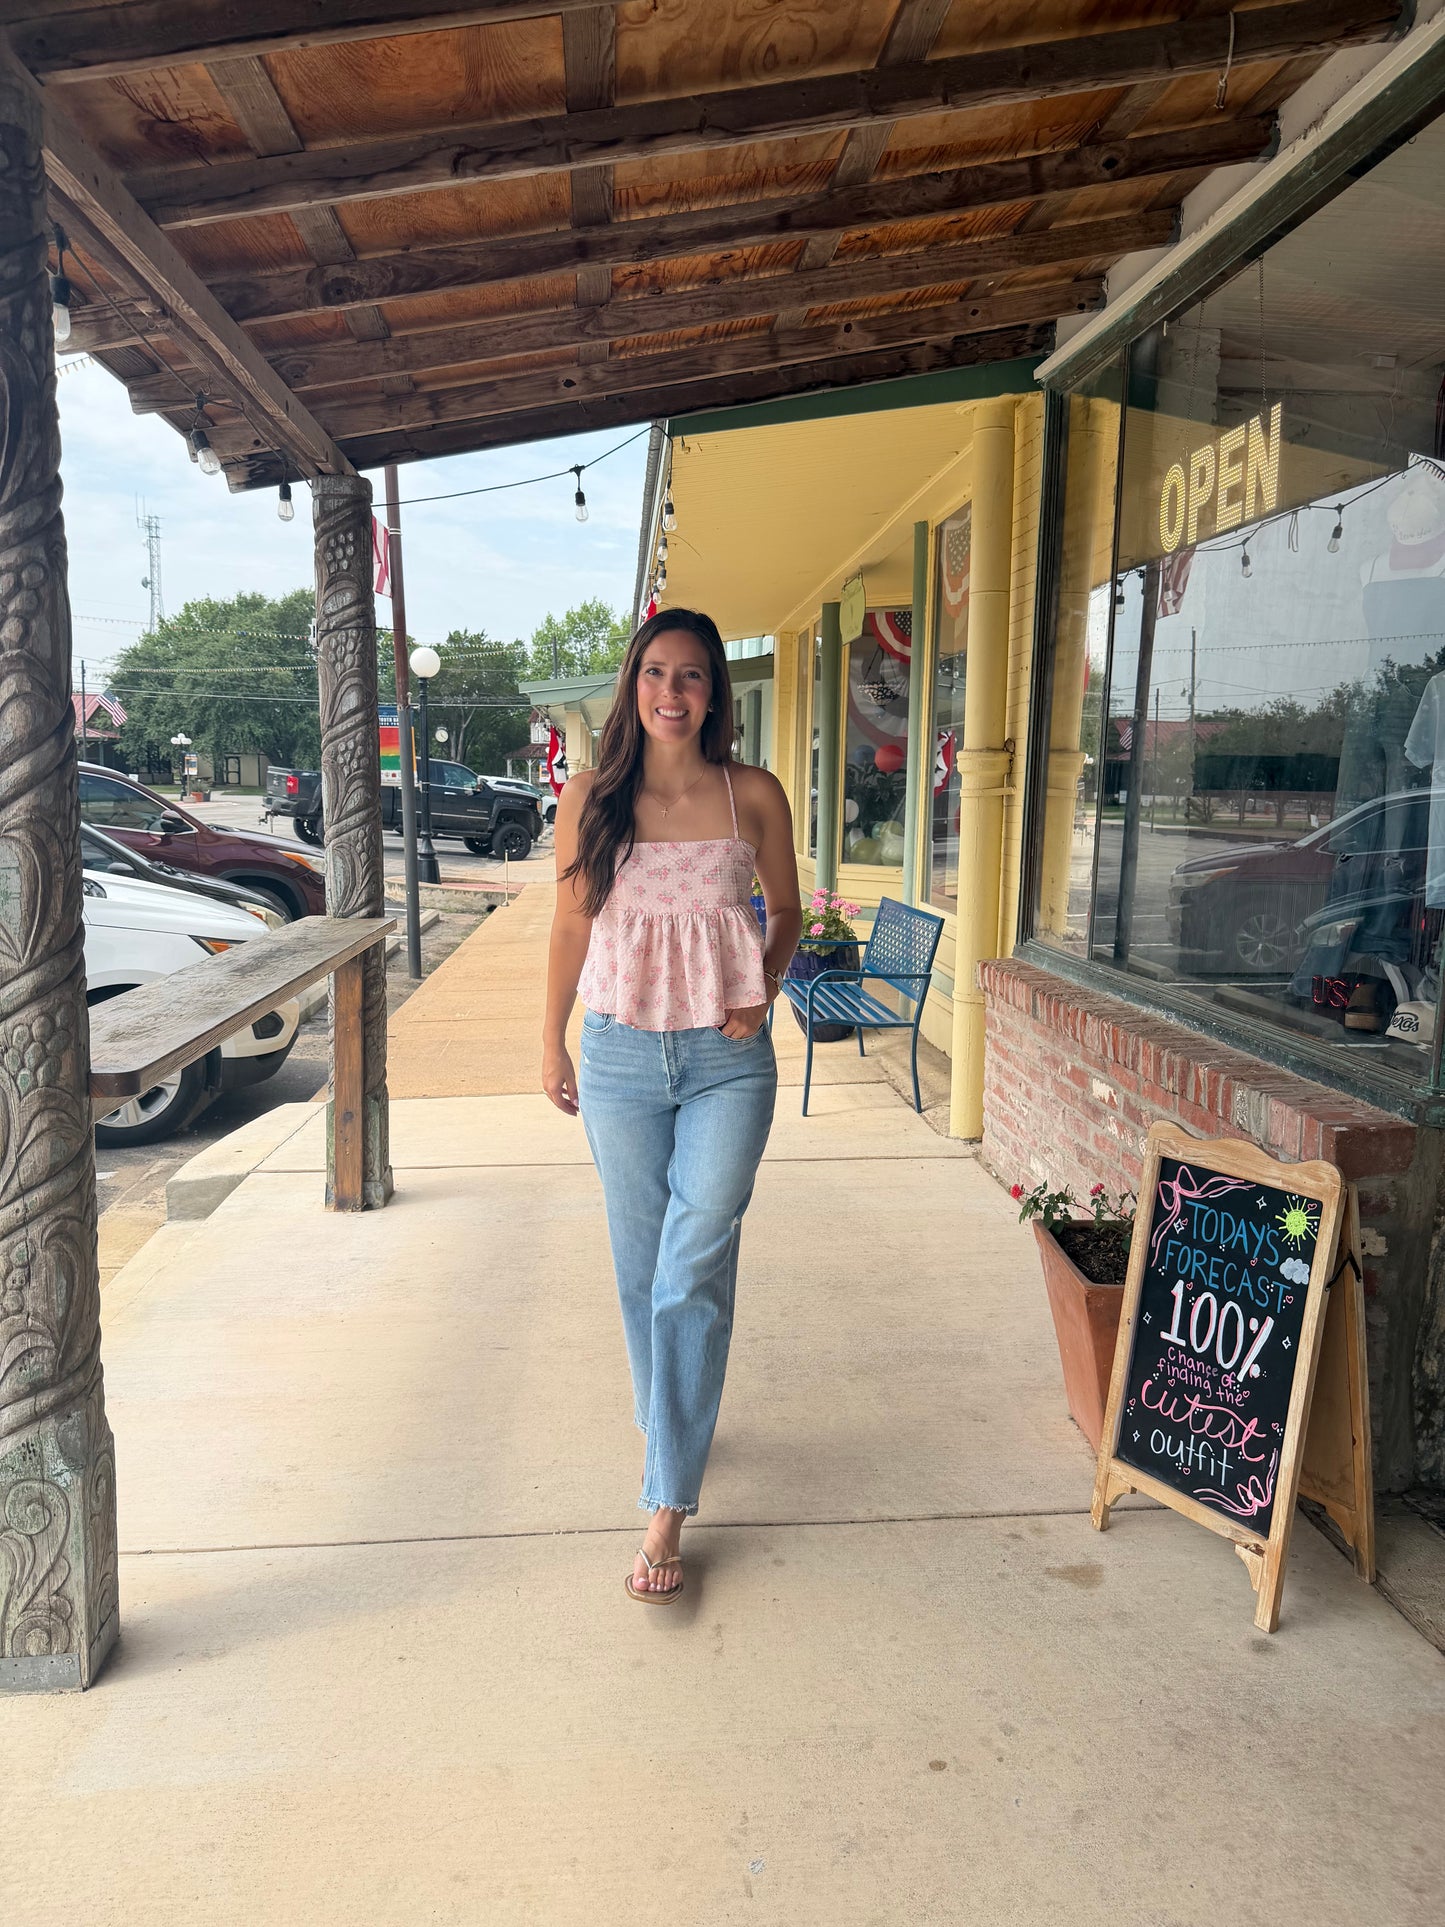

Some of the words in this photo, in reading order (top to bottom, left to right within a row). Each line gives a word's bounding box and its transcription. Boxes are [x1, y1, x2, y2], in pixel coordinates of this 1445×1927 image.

[1160, 402, 1282, 553] OPEN
[1312, 975, 1360, 1007] US
[1185, 1200, 1279, 1266] TODAY'S
[1165, 1239, 1291, 1314] FORECAST
[1160, 1280, 1274, 1382] 100%
[1157, 1358, 1212, 1398] finding
[1216, 1387, 1245, 1407] the
[1221, 1371, 1237, 1389] of
[1141, 1379, 1267, 1462] cutest
[1150, 1429, 1234, 1486] outfit
